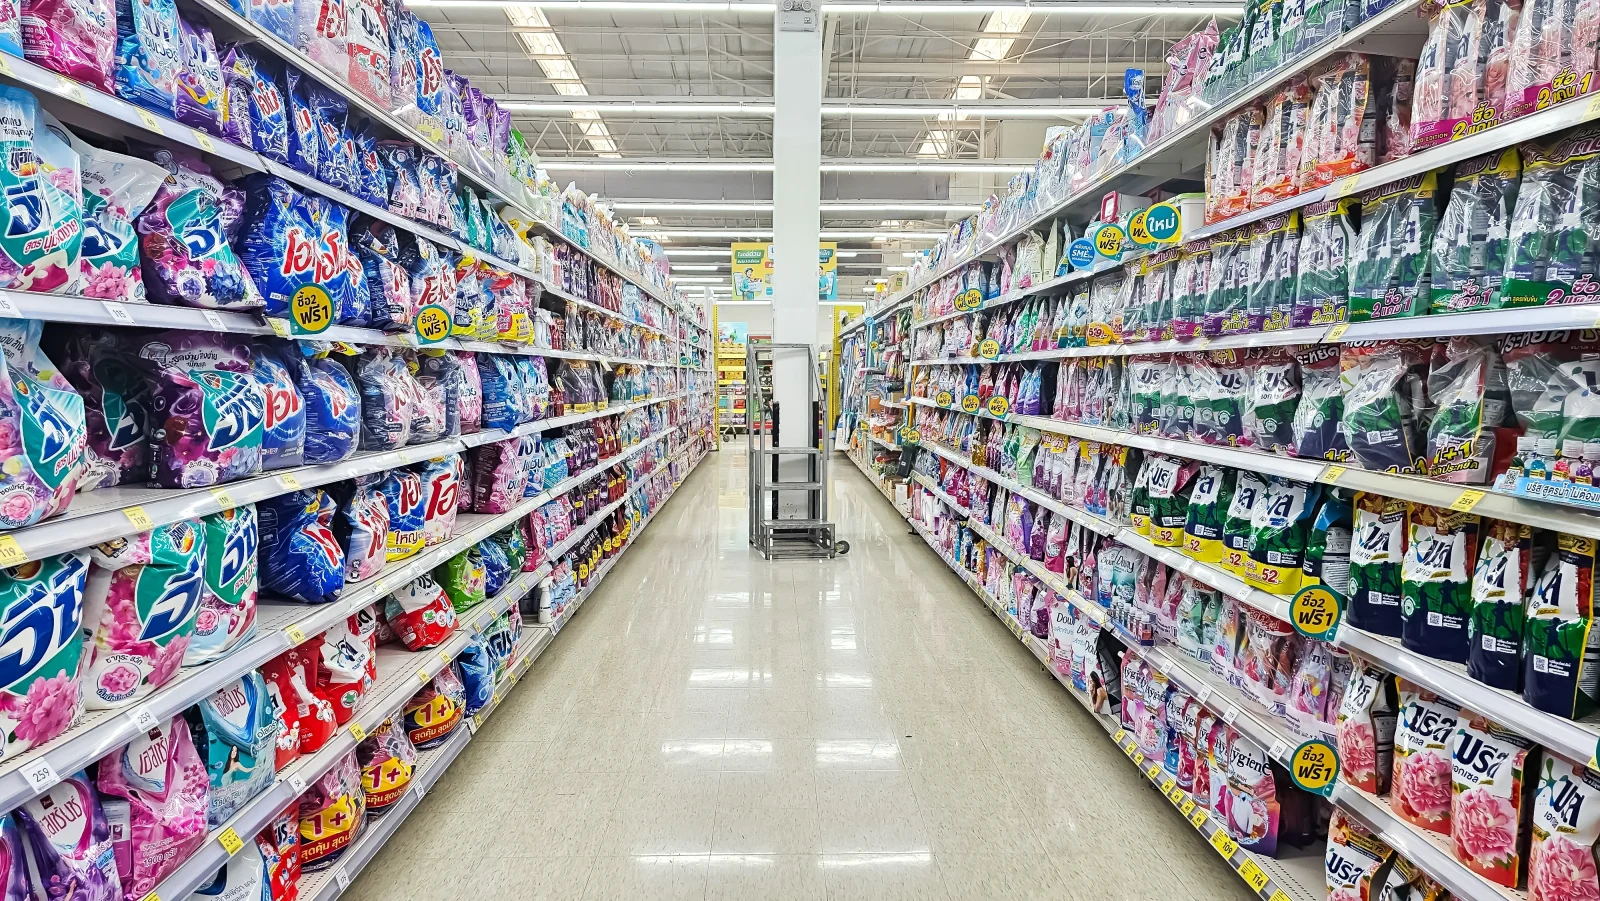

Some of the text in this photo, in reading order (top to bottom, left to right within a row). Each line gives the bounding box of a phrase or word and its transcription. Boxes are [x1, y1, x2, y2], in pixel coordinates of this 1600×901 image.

[1552, 66, 1577, 89] ซื้อ
[1536, 88, 1551, 111] 2
[1580, 72, 1592, 94] 1
[1473, 101, 1496, 123] ซื้อ
[1426, 132, 1448, 143] EDITION
[1452, 122, 1468, 140] 2
[1148, 213, 1175, 233] ใหม่
[1072, 250, 1087, 258] SME
[297, 291, 317, 308] ซื้อ2
[1544, 289, 1564, 306] 2
[300, 303, 329, 325] ฟรี1
[424, 319, 448, 337] ฟรี1
[1297, 345, 1341, 365] ระหยัด
[1526, 481, 1542, 494] บรีส
[1570, 486, 1600, 502] ไม่ต้องแ
[1458, 498, 1473, 506] 259
[135, 516, 147, 527] 119
[1301, 591, 1325, 608] ซื้อ2
[1057, 613, 1075, 626] Dow
[1299, 609, 1334, 627] ฟรี1
[137, 712, 151, 725] 259
[415, 728, 437, 742] สุดคุ้ม
[1302, 745, 1325, 763] ซื้อ2
[32, 767, 50, 784] 259
[1298, 763, 1333, 782] ฟรี1
[301, 842, 330, 860] สุดคุ้ม
[1222, 844, 1233, 854] 109
[1252, 873, 1265, 888] 114
